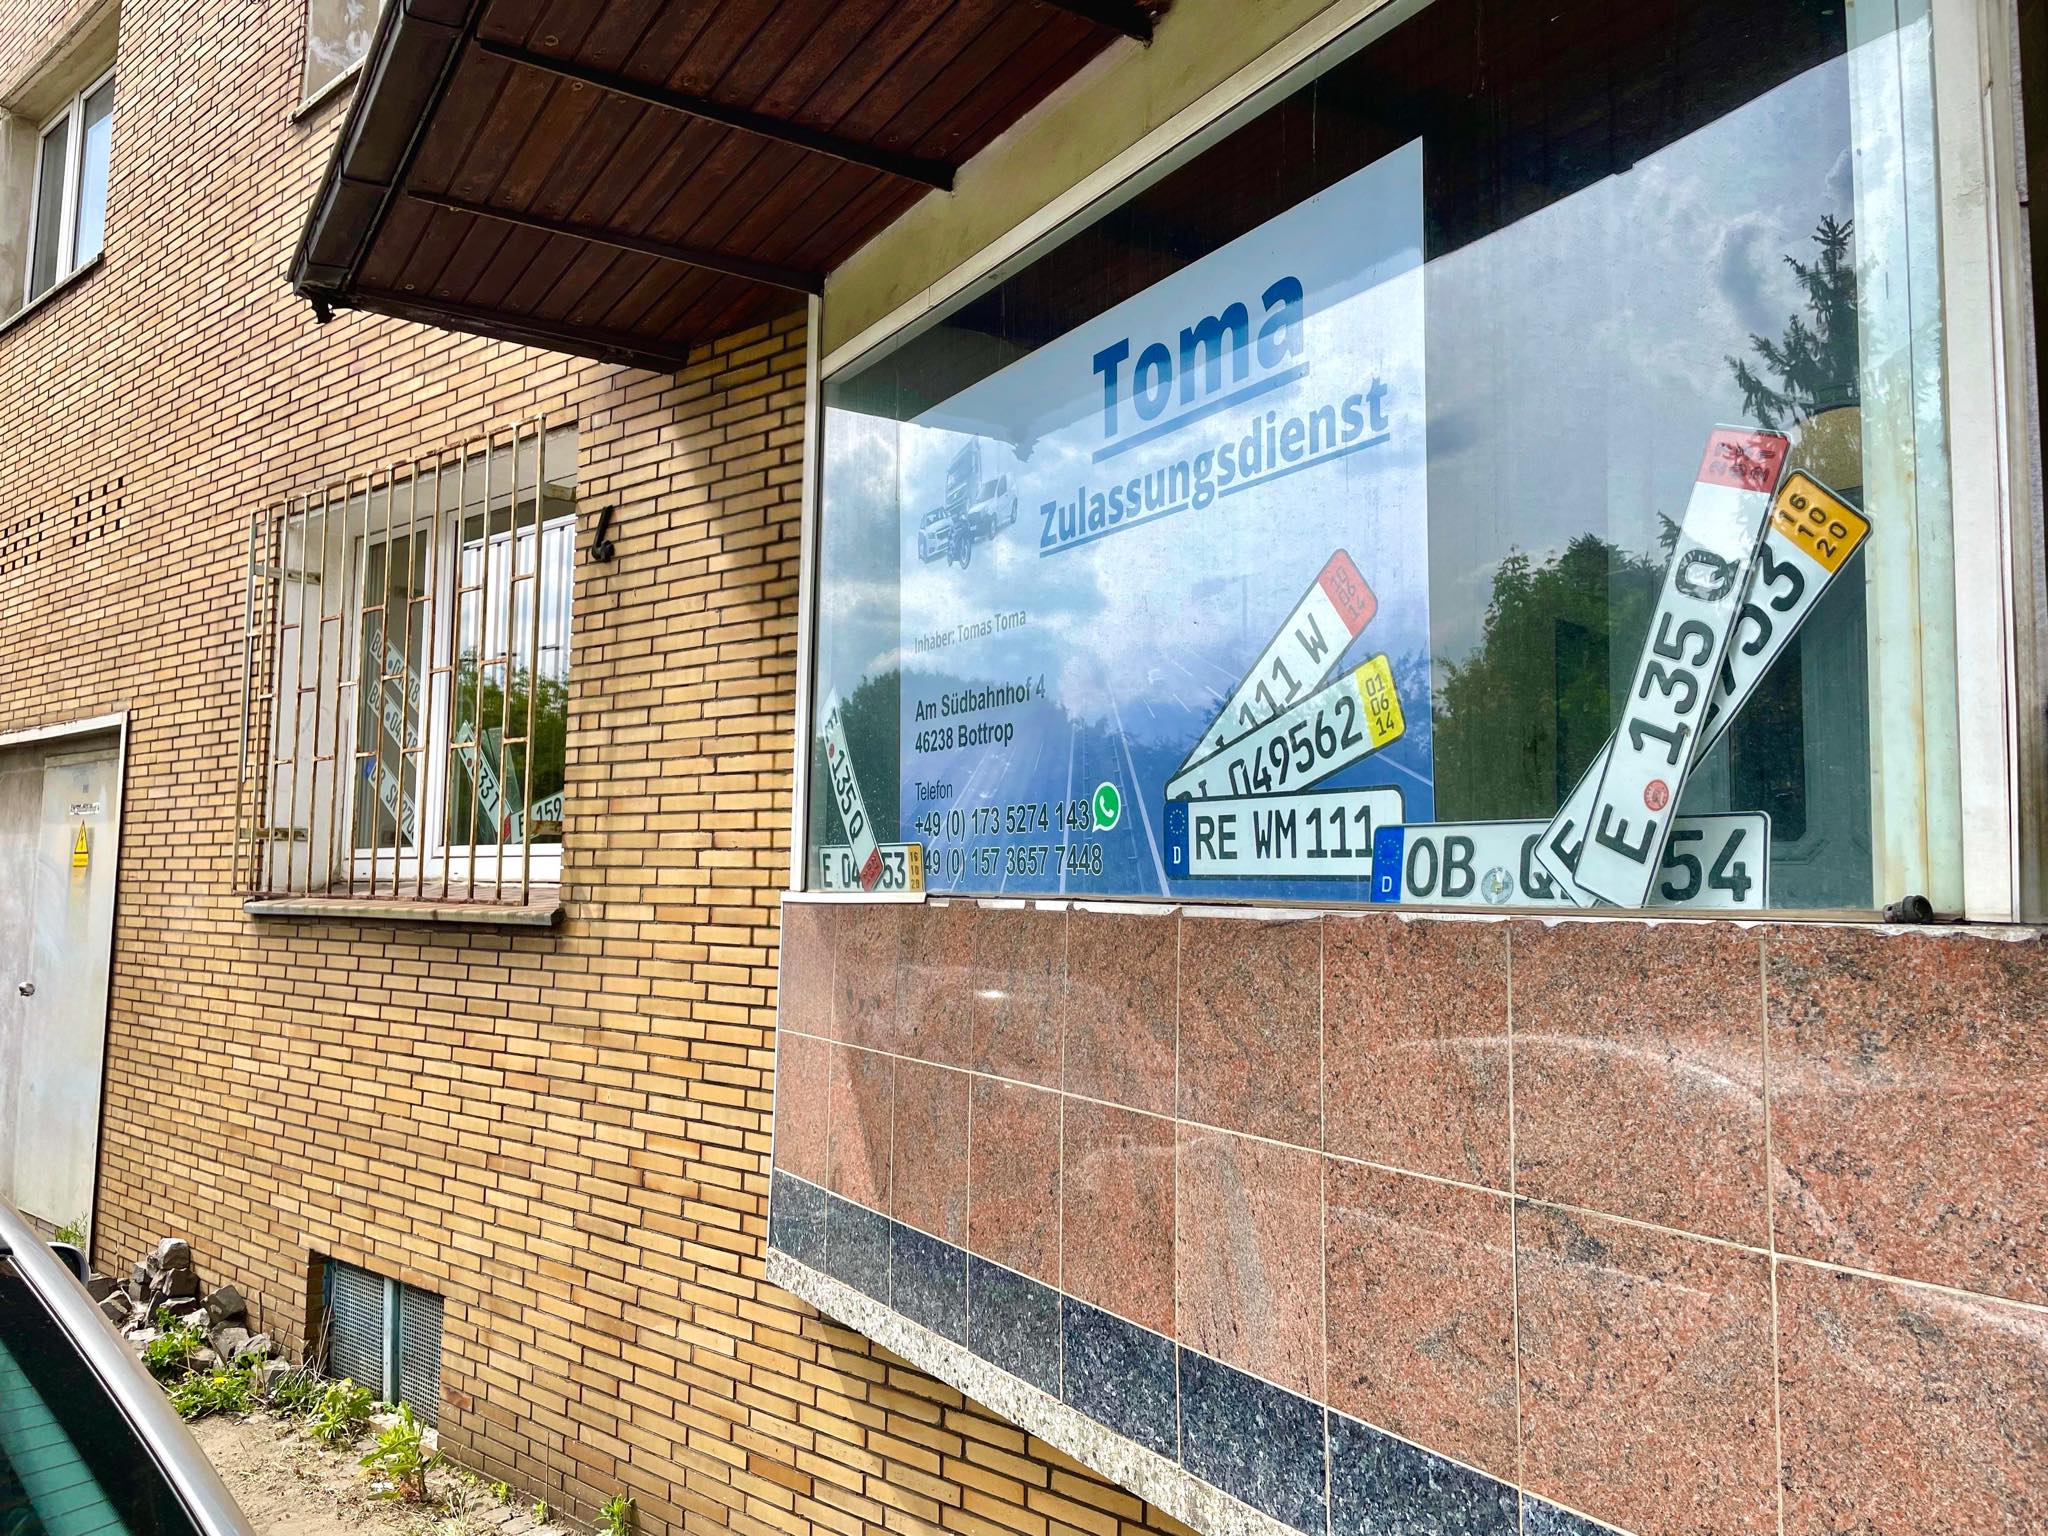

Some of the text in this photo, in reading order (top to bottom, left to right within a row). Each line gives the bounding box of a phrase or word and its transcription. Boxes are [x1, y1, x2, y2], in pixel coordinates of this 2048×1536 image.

[1093, 275, 1304, 438] Toma
[1039, 377, 1390, 548] Zulassungsdienst
[1779, 493, 1808, 525] 16
[1797, 507, 1827, 538] 10
[1816, 521, 1847, 558] 20
[914, 610, 1027, 654] Inhaber: Tomas Toma
[1239, 613, 1330, 730] 111 W
[1365, 673, 1385, 697] 01
[915, 673, 1046, 721] Am Südbahnhof 4
[1370, 696, 1389, 716] 06
[1595, 549, 1741, 864] E 135Q
[915, 720, 1014, 754] 46238 Bottrop
[1375, 712, 1395, 737] 14
[831, 749, 864, 844] 135Q
[915, 781, 953, 801] Telefon
[915, 799, 1090, 842] +49 (0) 173 5274 143
[1173, 804, 1374, 864] D RE WM 111
[823, 853, 833, 888] E
[842, 852, 906, 890] 0453
[924, 843, 1103, 881] 49 (0) 157 3657 7448
[1381, 875, 1392, 893] D
[1405, 835, 1476, 898] OB
